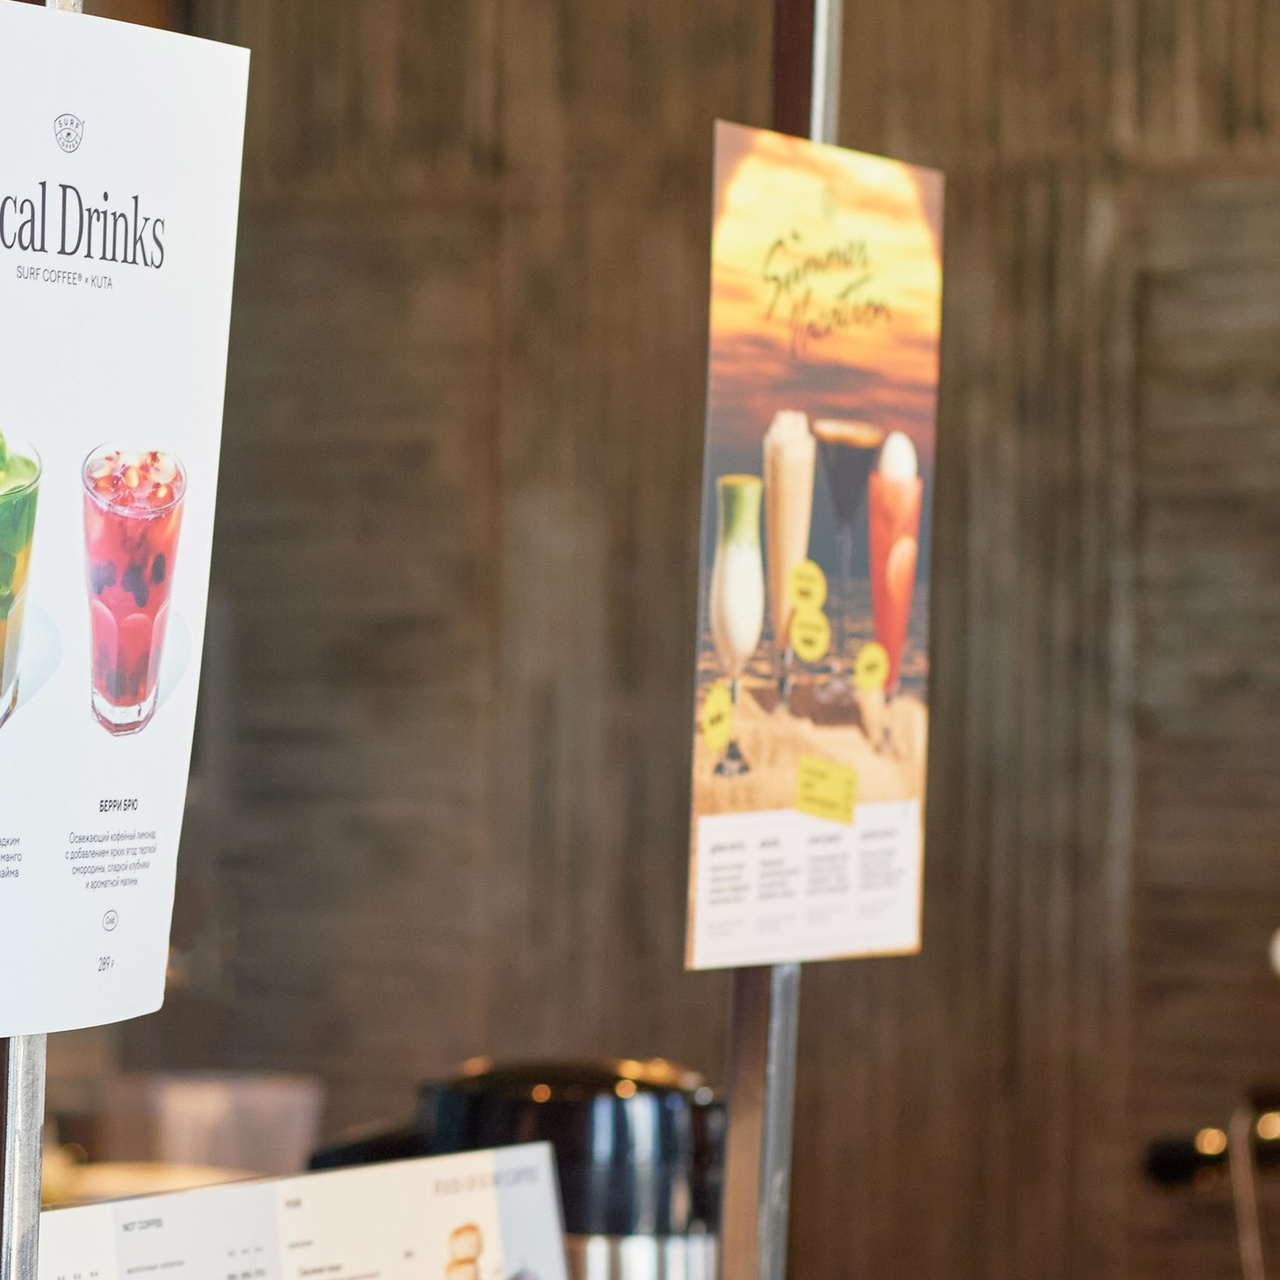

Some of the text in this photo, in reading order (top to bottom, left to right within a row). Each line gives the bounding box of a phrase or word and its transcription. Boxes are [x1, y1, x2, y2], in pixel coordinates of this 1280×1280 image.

[58, 118, 79, 129] SURF
[57, 183, 165, 270] Drinks
[16, 265, 41, 281] SURF
[91, 275, 113, 290] KUTA
[99, 799, 138, 812] БЕРРИ БРЮ
[69, 830, 109, 843] Освежающий
[0, 853, 22, 862] манго
[98, 956, 110, 971] 289
